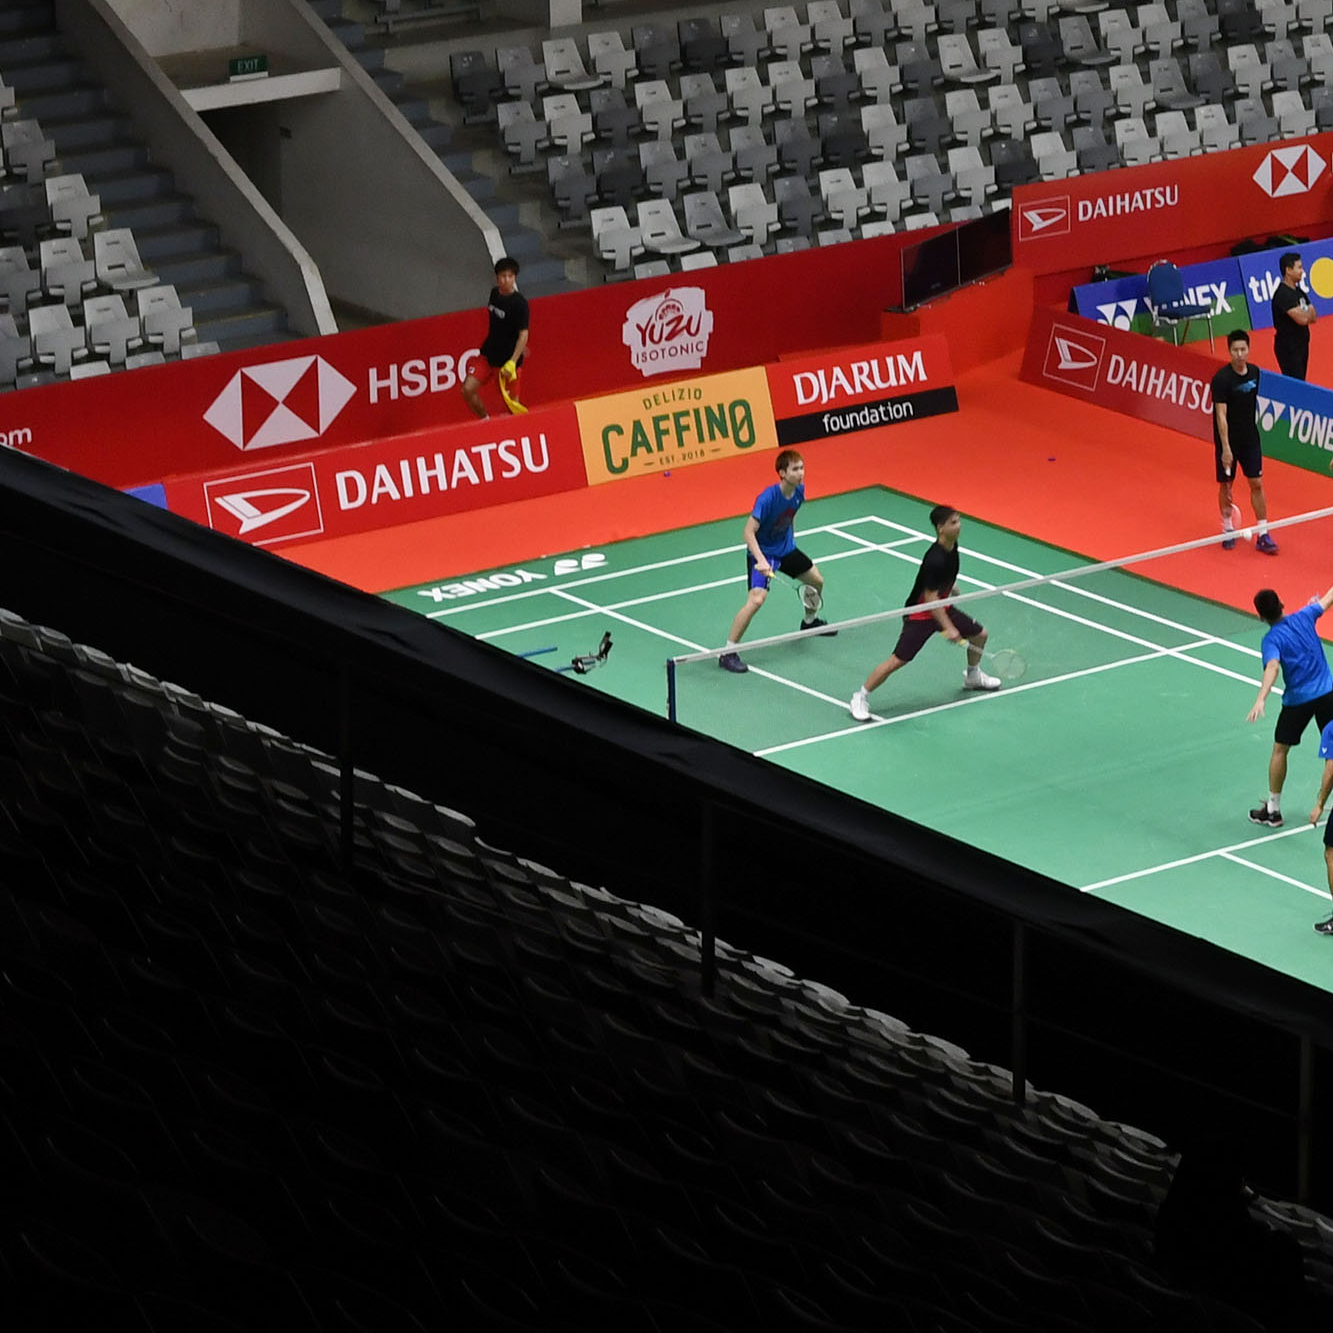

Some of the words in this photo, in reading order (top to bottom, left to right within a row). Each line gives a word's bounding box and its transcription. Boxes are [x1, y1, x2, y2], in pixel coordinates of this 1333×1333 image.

[237, 58, 259, 73] EXIT
[1077, 184, 1180, 222] DAIHATSU
[635, 311, 702, 348] YUZU
[635, 339, 705, 365] ISOTONIC
[792, 350, 928, 406] DJARUM
[642, 387, 703, 411] DELIZIO
[822, 399, 915, 434] foundation
[601, 397, 757, 475] CAFFINO
[336, 433, 551, 511] DAIHATSU
[416, 568, 548, 603] YONEX
